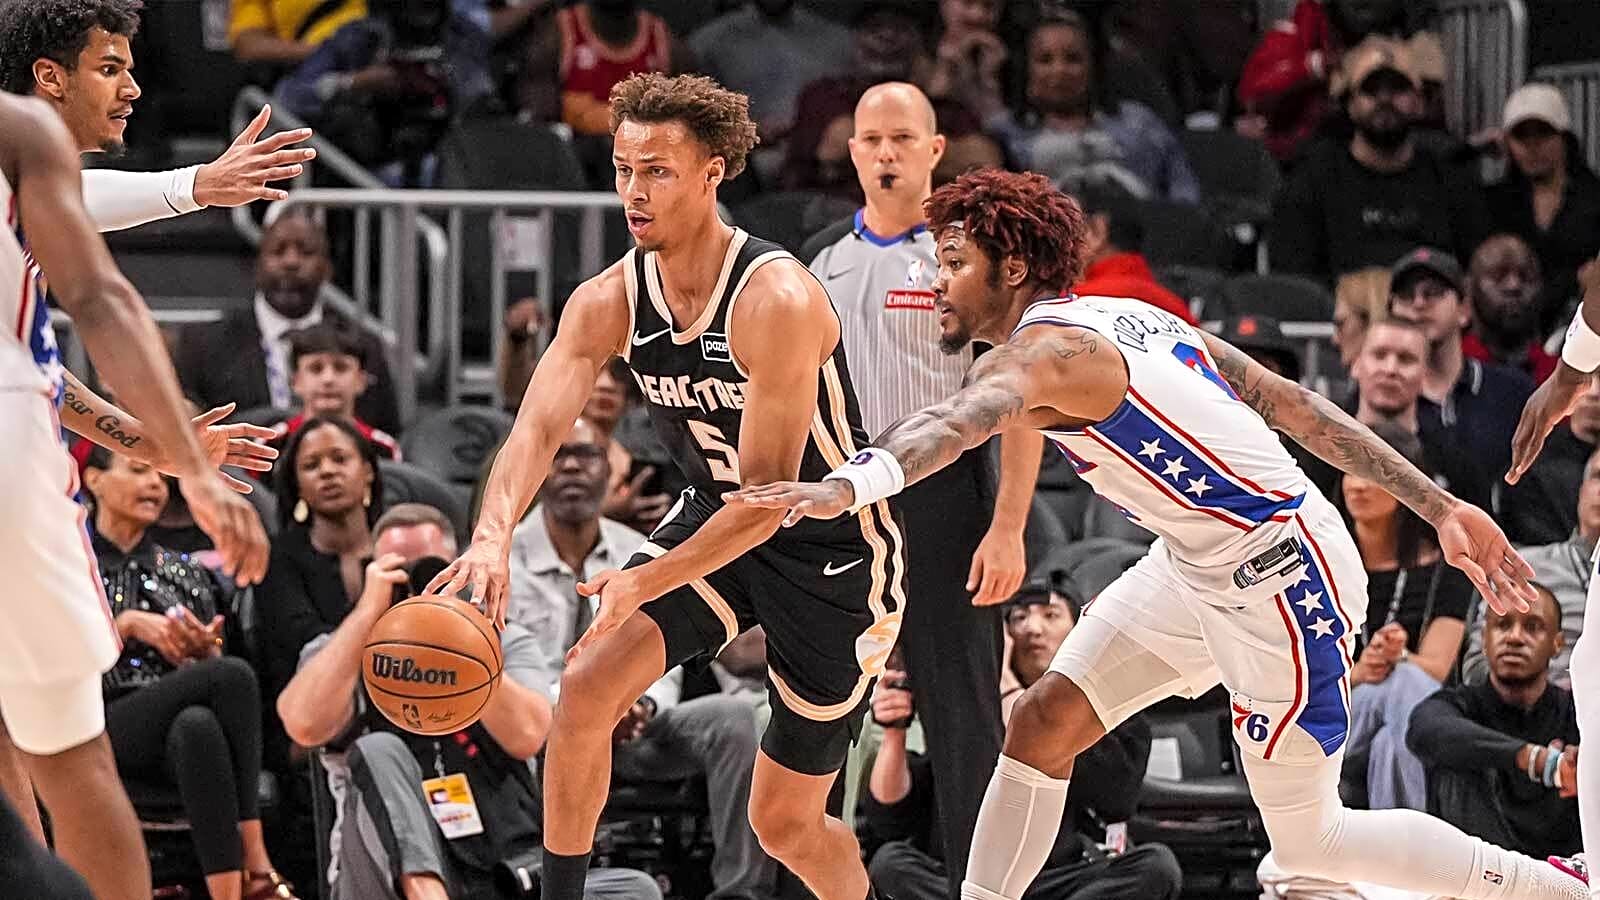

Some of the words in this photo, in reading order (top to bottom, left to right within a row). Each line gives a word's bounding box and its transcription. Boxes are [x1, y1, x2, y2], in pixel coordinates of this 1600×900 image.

[95, 415, 141, 448] God
[687, 419, 741, 485] 5
[373, 653, 457, 685] Wilson
